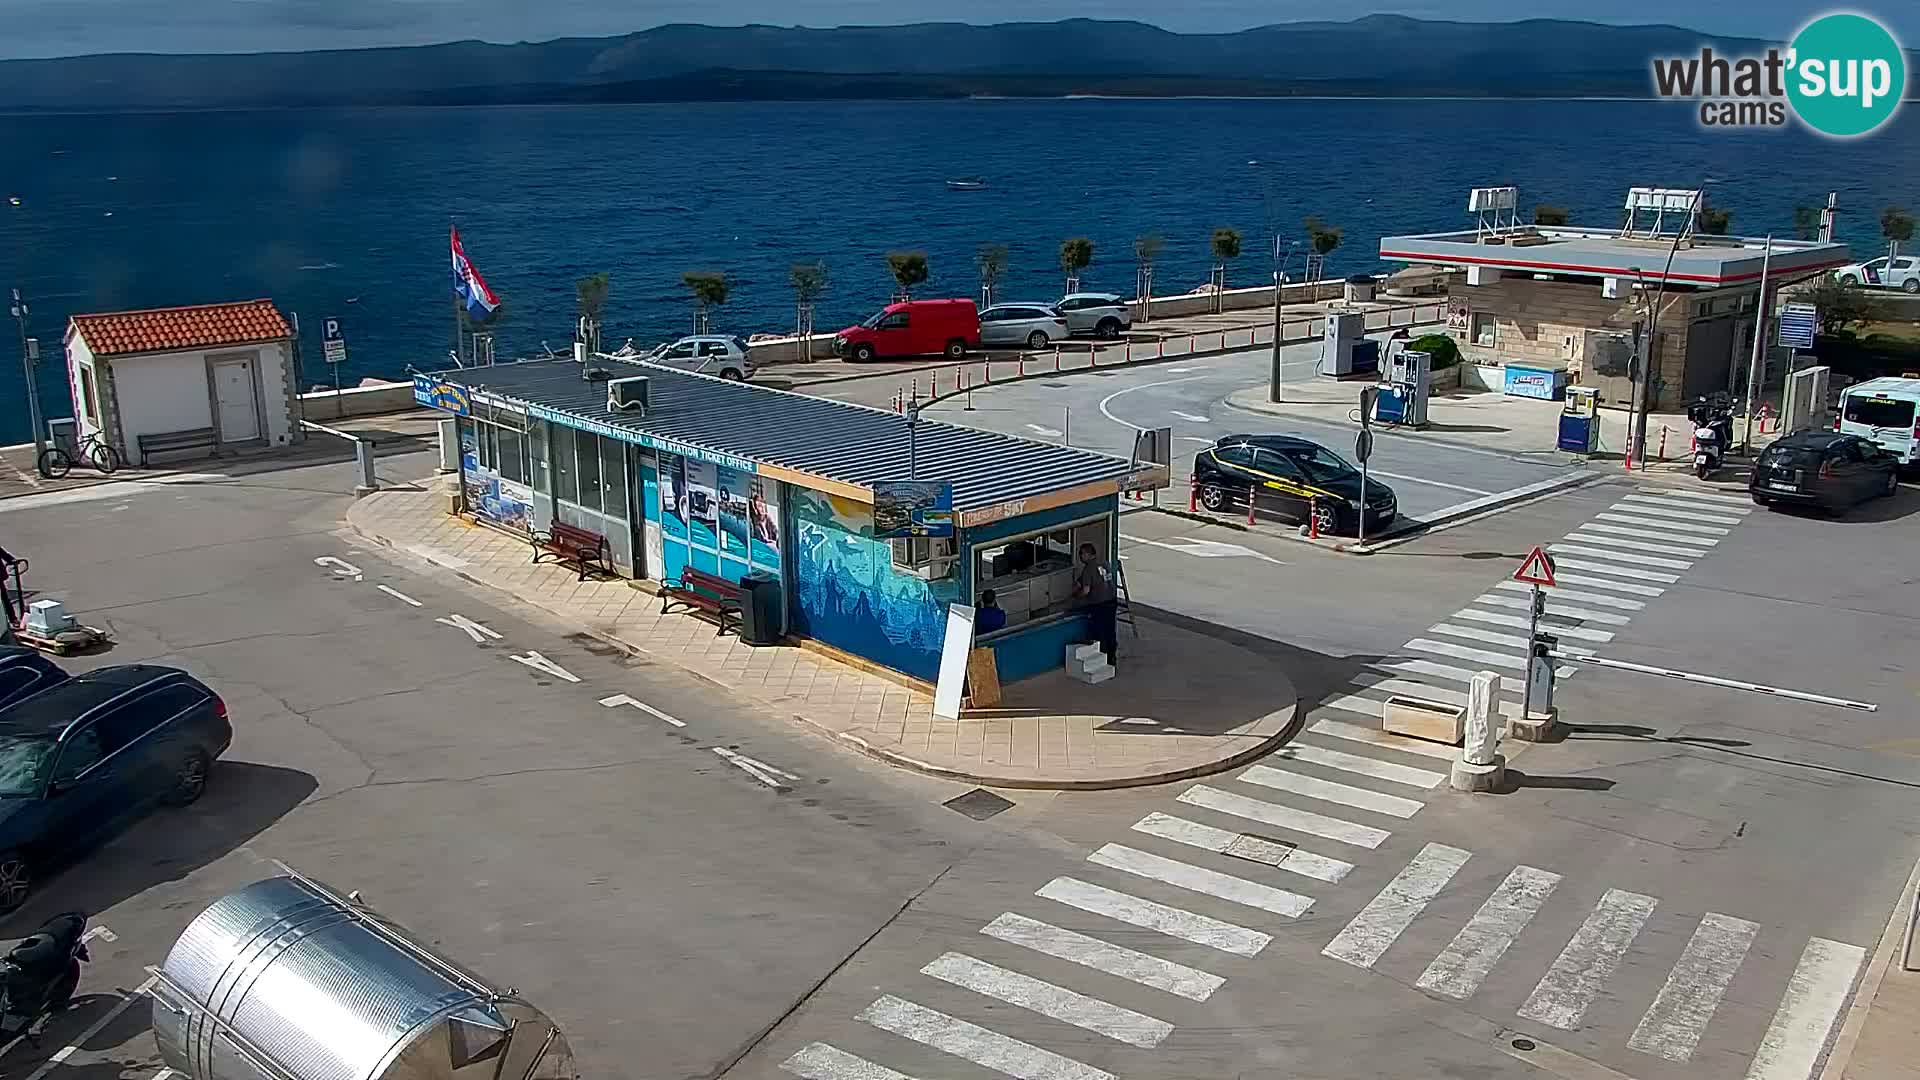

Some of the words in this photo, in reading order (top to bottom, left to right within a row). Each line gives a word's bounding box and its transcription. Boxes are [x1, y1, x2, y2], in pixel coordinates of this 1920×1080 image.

[327, 320, 338, 338] P
[613, 428, 642, 445] POSTAJA
[652, 438, 667, 451] BUS
[667, 443, 700, 459] STATION
[701, 450, 726, 466] TICKET
[727, 456, 754, 472] OFFICE
